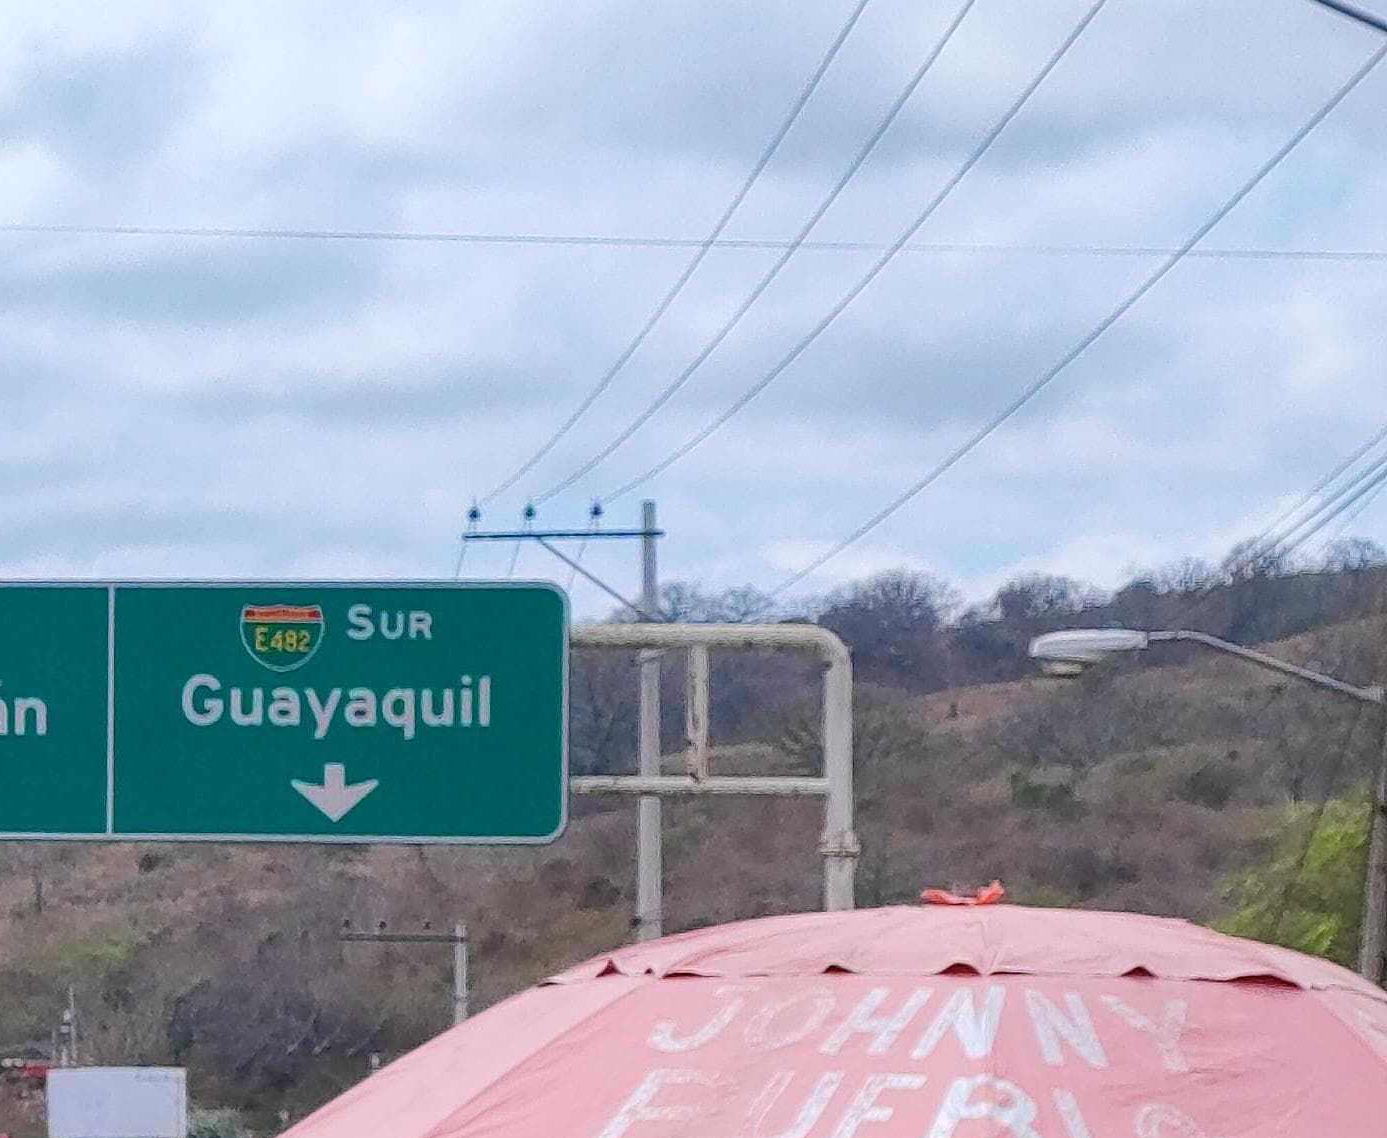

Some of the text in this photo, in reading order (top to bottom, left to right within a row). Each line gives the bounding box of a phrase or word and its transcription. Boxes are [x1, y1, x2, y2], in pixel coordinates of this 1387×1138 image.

[254, 625, 311, 653] E482
[345, 605, 433, 641] SUR
[181, 673, 492, 740] Guayaquil
[648, 984, 1192, 1074] JOHNNY
